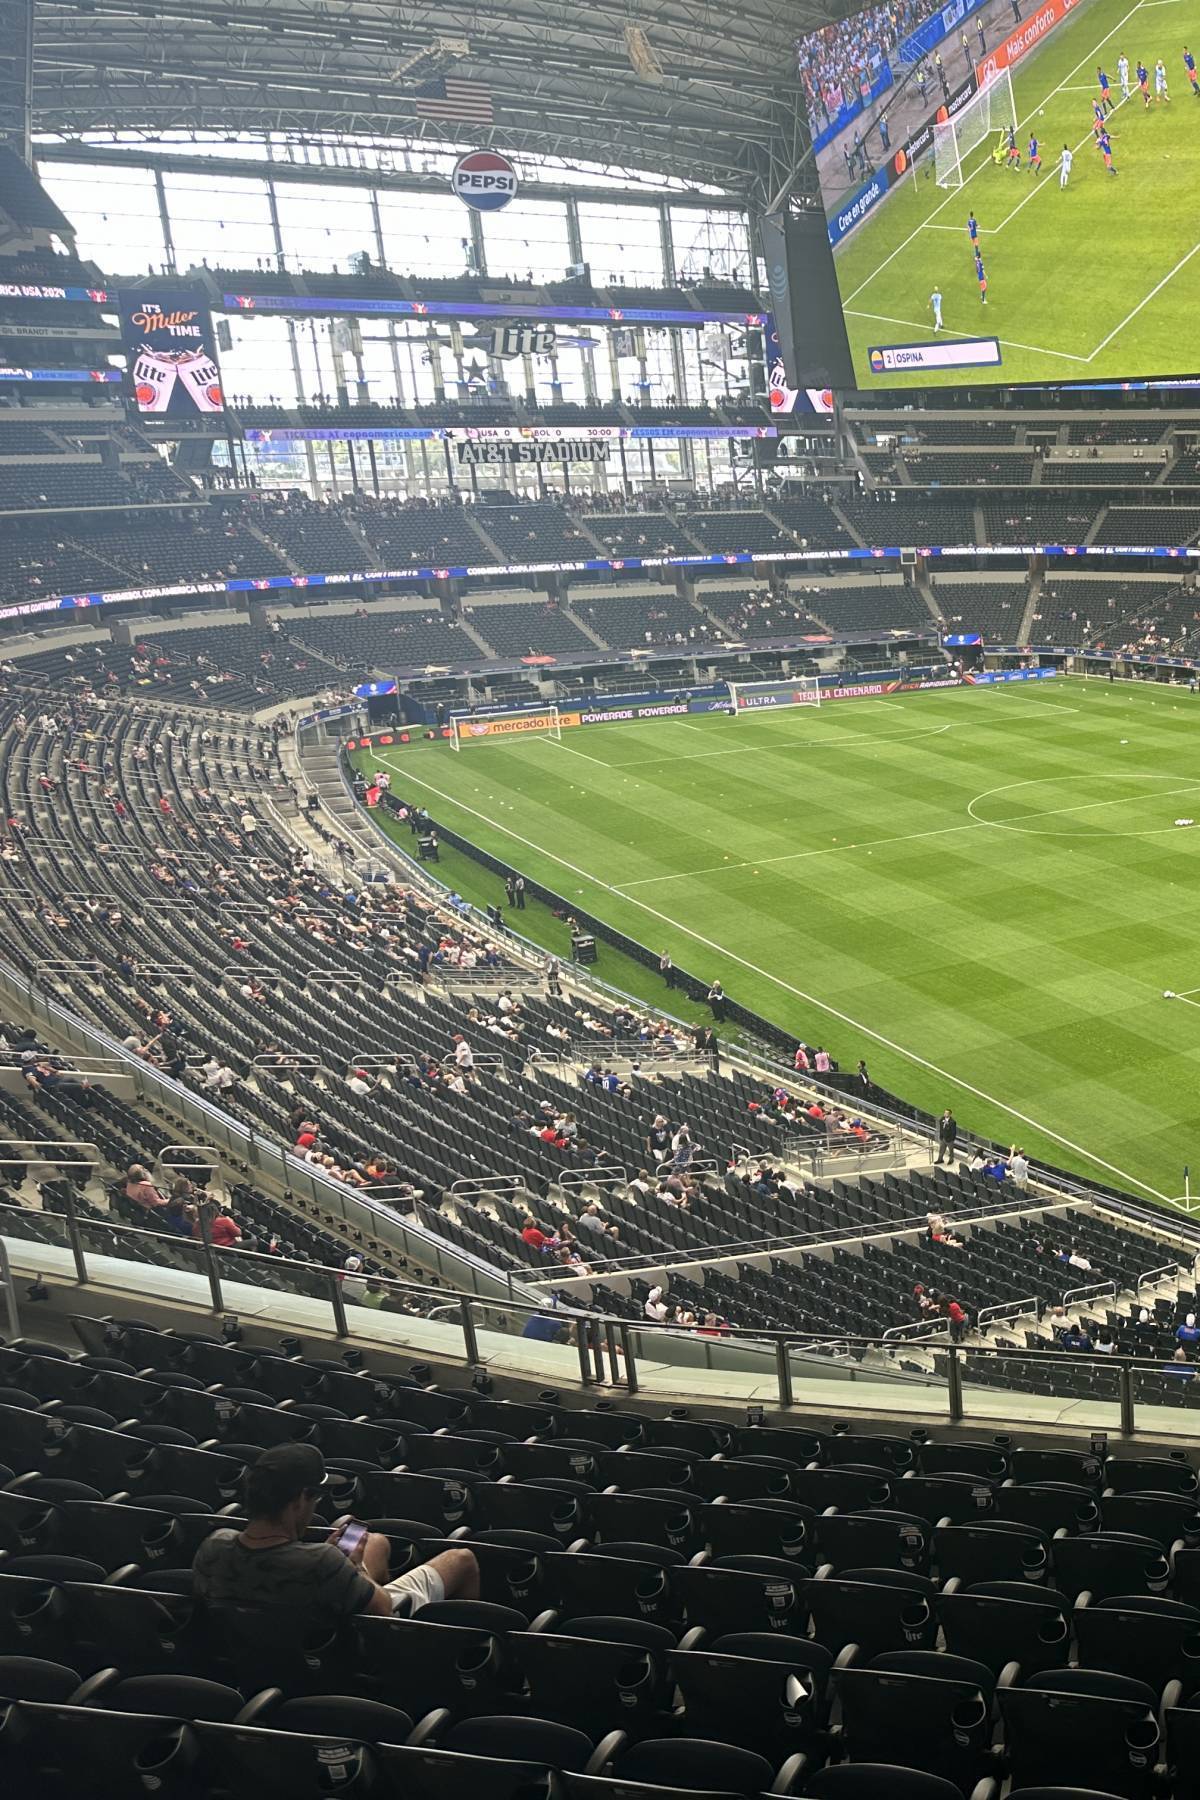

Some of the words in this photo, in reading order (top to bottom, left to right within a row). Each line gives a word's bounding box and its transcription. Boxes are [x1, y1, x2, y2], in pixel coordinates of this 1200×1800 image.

[1007, 33, 1028, 59] Mais
[949, 84, 973, 112] mastercard
[457, 173, 514, 191] PEPSI
[838, 214, 853, 232] Cree
[851, 206, 860, 218] en
[859, 182, 880, 213] grande
[22, 285, 42, 297] USA
[43, 286, 66, 298] 2024
[142, 304, 161, 314] IT'S
[132, 311, 199, 334] Miller
[16, 327, 49, 336] BRANDT
[168, 325, 201, 337] TIME
[486, 325, 557, 361] Lite
[886, 355, 892, 364] 2
[896, 353, 924, 364] OSPINA
[135, 361, 167, 383] Lite
[190, 363, 218, 386] Lite
[481, 429, 498, 437] USA
[504, 429, 510, 437] 0
[533, 429, 551, 437] BOL
[556, 429, 562, 437] 0
[587, 428, 612, 437] 30:00
[460, 444, 515, 465] AT&T
[517, 442, 610, 463] STADIUM
[466, 565, 508, 576] CONMEBOL
[324, 573, 351, 585] VIBRA
[352, 572, 364, 582] EL
[102, 590, 142, 604] CONMEBOL
[798, 690, 831, 701] TEQUILA
[833, 684, 882, 698] CENTENARIO
[746, 696, 777, 706] ULTRA
[581, 710, 634, 724] POWERADE
[638, 704, 689, 718] POWERADE
[493, 718, 543, 733] mercado
